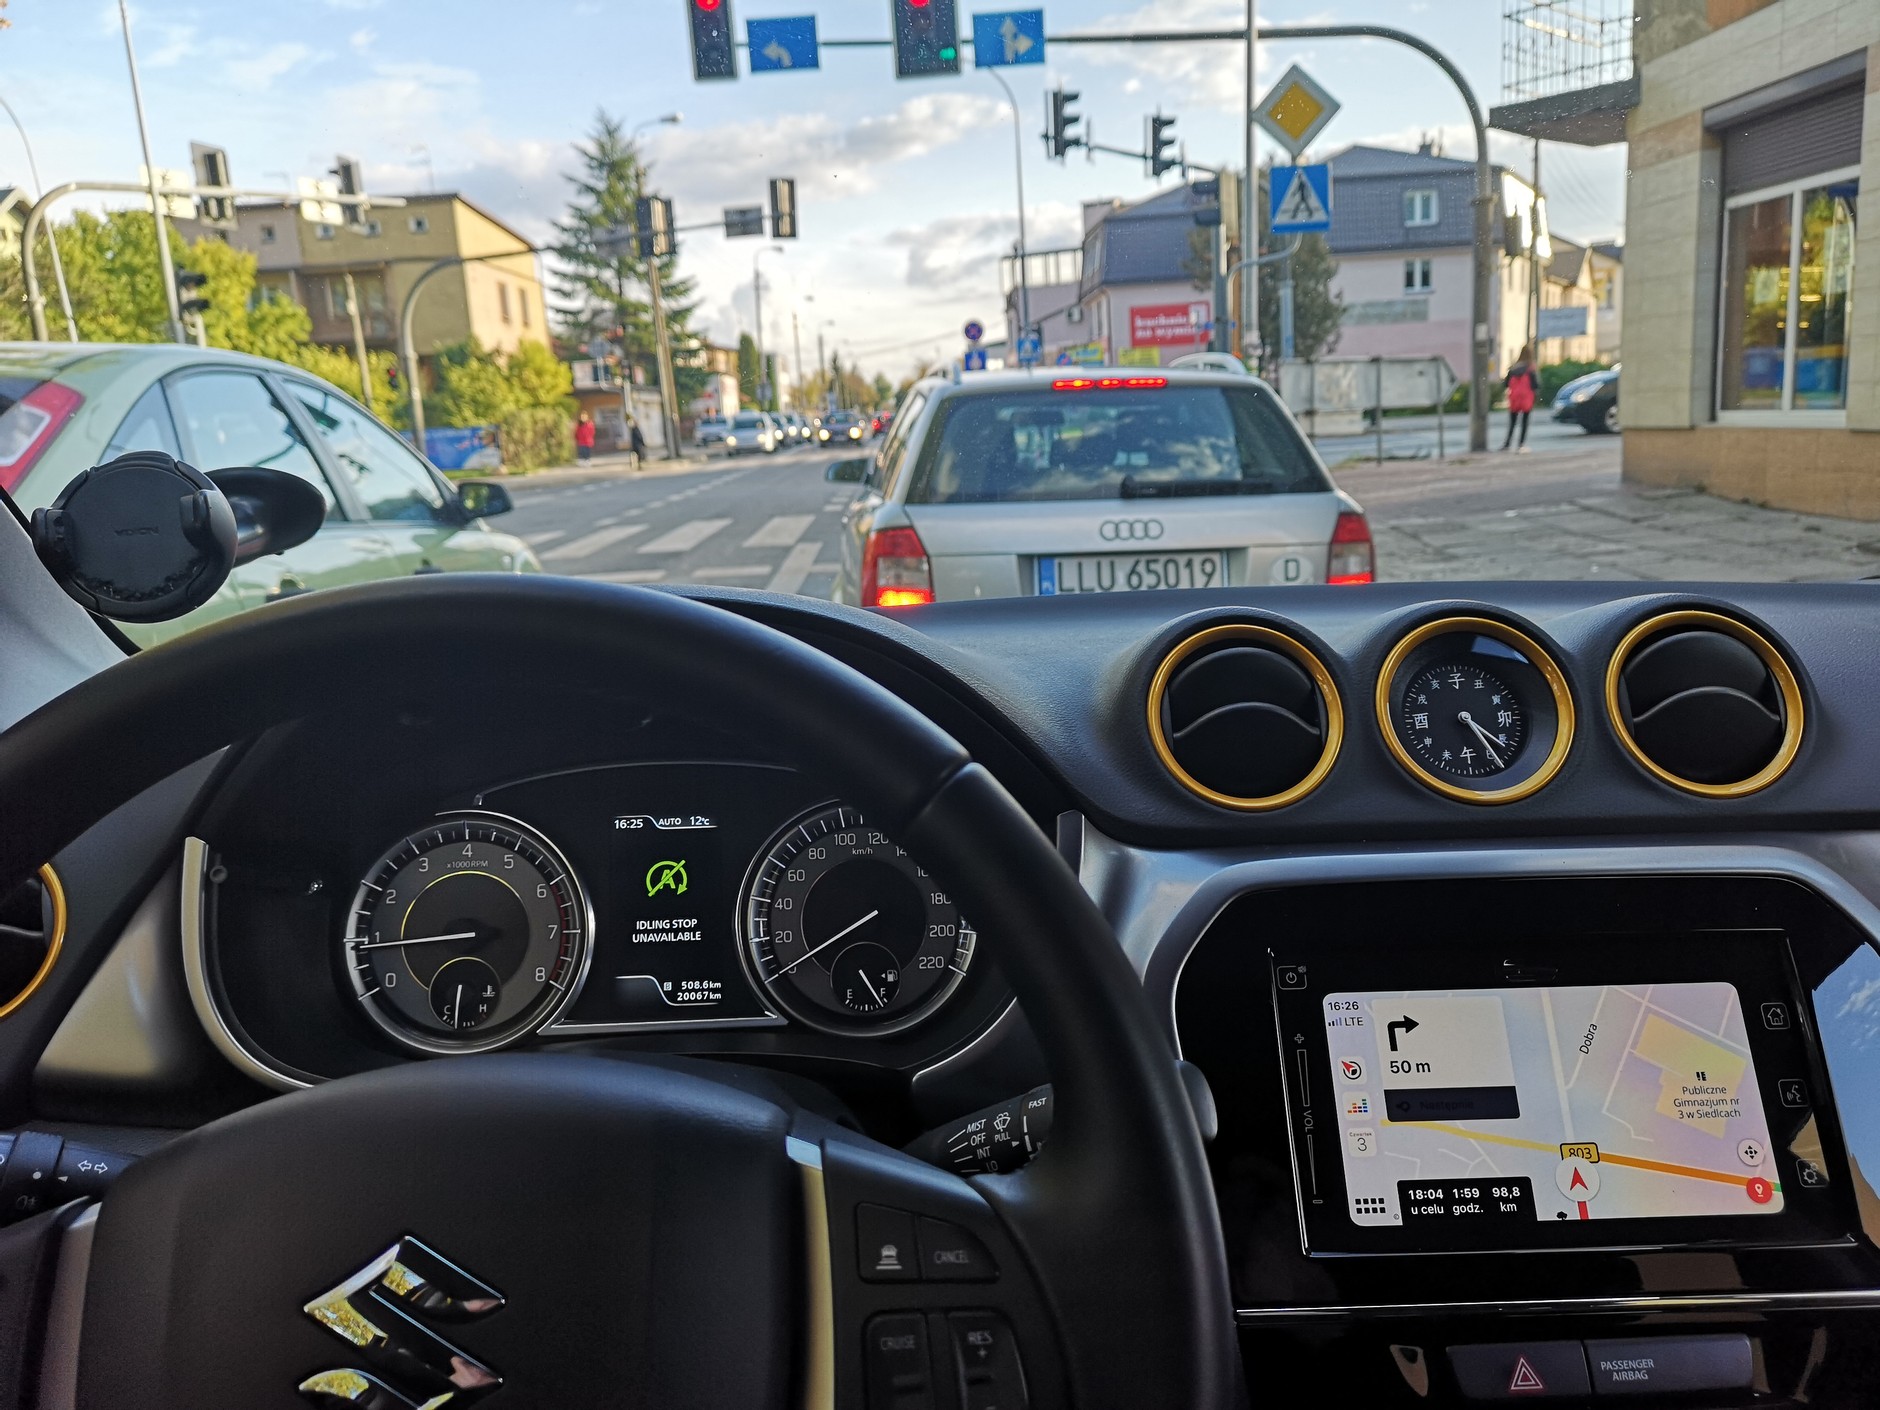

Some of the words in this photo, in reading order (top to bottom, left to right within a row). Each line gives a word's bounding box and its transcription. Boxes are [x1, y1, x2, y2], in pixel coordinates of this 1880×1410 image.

[1058, 561, 1115, 592] LLU
[1127, 558, 1216, 590] 65019
[1284, 559, 1300, 581] D
[1430, 679, 1441, 690] 亥
[1448, 673, 1465, 689] 子
[1474, 679, 1485, 689] 丑
[1492, 694, 1502, 705] 寅
[1413, 712, 1430, 730] 酉
[1498, 710, 1512, 728] 卯
[1424, 737, 1432, 747] 申
[1460, 747, 1477, 764] 午
[614, 819, 644, 829] 16:25
[658, 818, 682, 826] AUTO
[834, 833, 856, 845] 100
[463, 844, 473, 858] 4
[808, 848, 826, 860] 80
[852, 847, 873, 856] km/h
[419, 858, 429, 872] 3
[504, 855, 514, 869] 5
[787, 869, 806, 882] 60
[386, 890, 397, 904] 2
[536, 884, 547, 898] 6
[775, 898, 793, 910] 40
[636, 920, 671, 930] IDLING
[672, 919, 698, 929] STOP
[929, 924, 955, 937] 200
[374, 932, 381, 943] 1
[547, 925, 558, 939] 7
[632, 931, 702, 943] UNAVAILABLE
[775, 931, 793, 943] 20
[918, 956, 944, 969] 220
[385, 973, 397, 987] 0
[535, 967, 546, 982] 8
[847, 989, 853, 999] E
[880, 987, 886, 997] F
[444, 1004, 451, 1015] C
[479, 1004, 487, 1013] H
[1328, 1001, 1360, 1012] 16:26
[1344, 1017, 1363, 1027] LTE
[1579, 1023, 1598, 1055] Dobra
[1390, 1060, 1412, 1074] 50
[1416, 1062, 1431, 1073] m
[1682, 1086, 1727, 1095] Publiczne
[1028, 1097, 1047, 1109] FAST
[1673, 1098, 1727, 1108] Gimnazjum
[1730, 1098, 1740, 1106] nr
[1678, 1110, 1684, 1119] 3
[1696, 1108, 1741, 1118] Siedlcach
[966, 1118, 987, 1133] MIST
[1303, 1110, 1314, 1133] VOL
[970, 1133, 987, 1147] OFF
[994, 1132, 1010, 1143] PULL
[1357, 1137, 1367, 1152] 3
[977, 1146, 991, 1160] INT
[986, 1161, 998, 1173] LO
[1408, 1188, 1444, 1200] 18:04
[1453, 1188, 1480, 1199] 1:59
[1492, 1187, 1521, 1199] 98,8
[1411, 1206, 1418, 1215] u
[1421, 1203, 1444, 1214] celu
[1453, 1202, 1484, 1216] godz.
[1500, 1202, 1517, 1212] km
[934, 1250, 969, 1264] CANCEL
[1600, 1358, 1654, 1371] PASSENGER
[1612, 1370, 1648, 1381] AIRBAG
